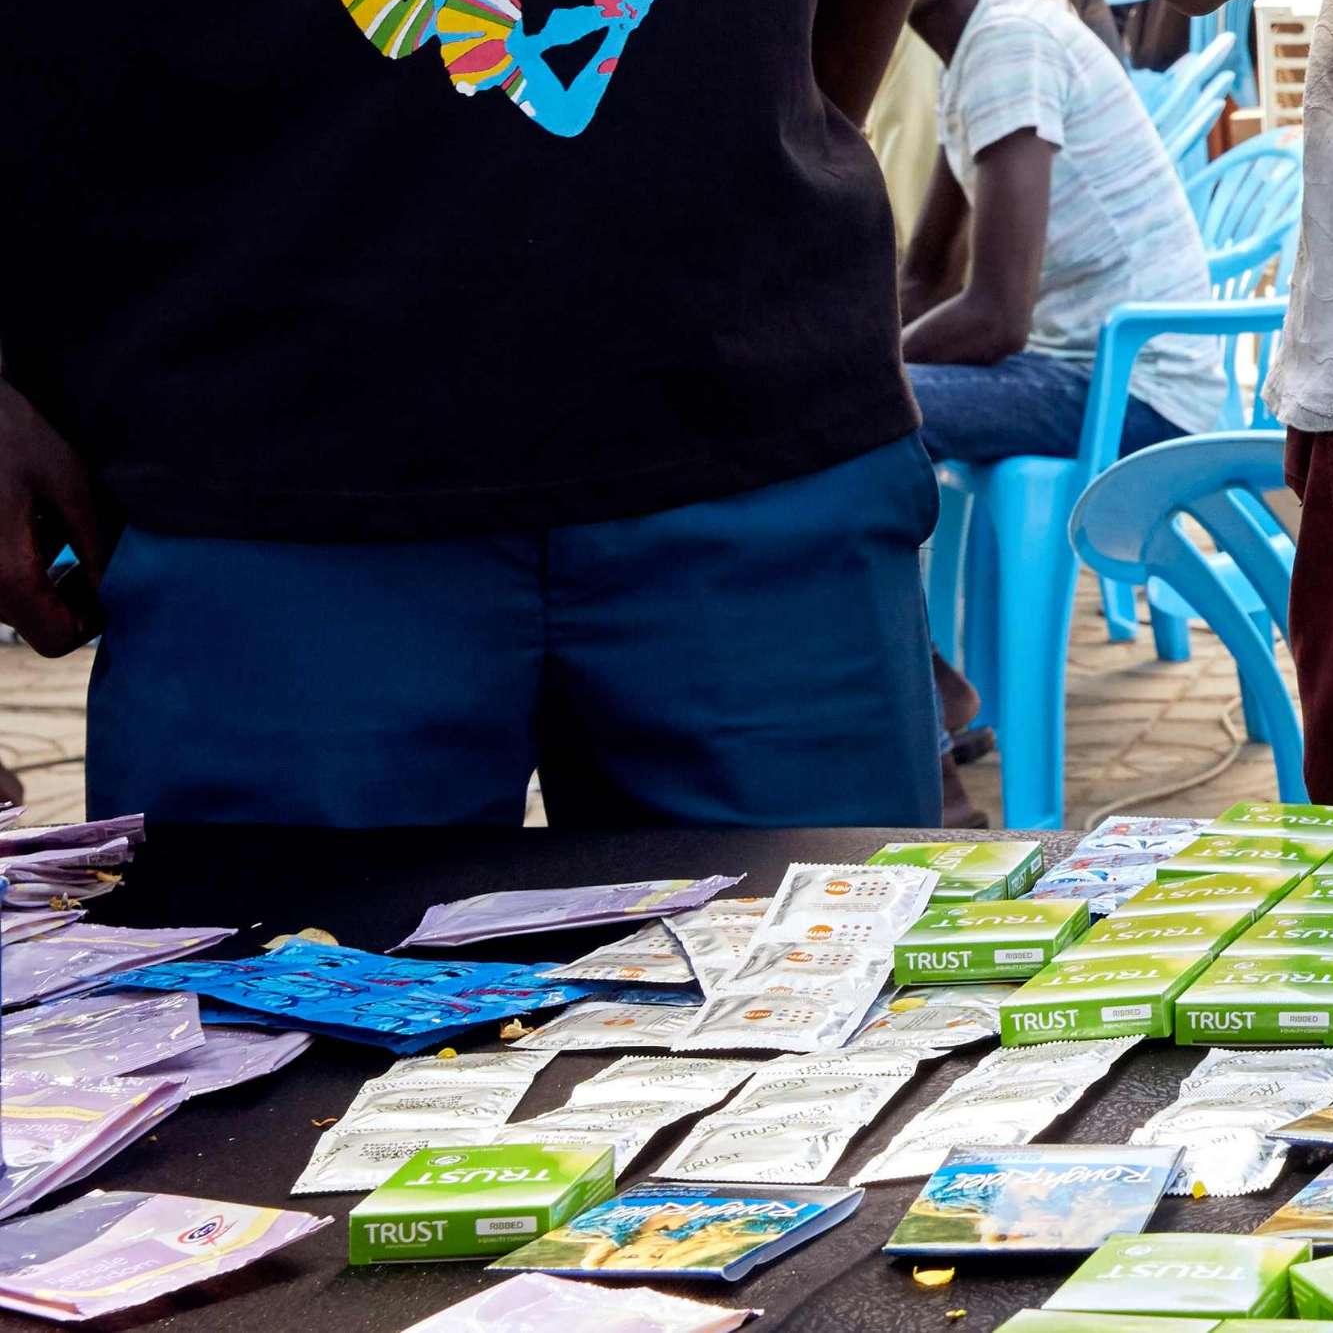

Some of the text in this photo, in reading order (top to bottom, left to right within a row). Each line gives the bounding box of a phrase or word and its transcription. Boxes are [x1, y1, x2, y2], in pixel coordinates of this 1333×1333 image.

[1194, 849, 1299, 861] TRUST
[1146, 886, 1254, 901] TRUST
[935, 914, 1048, 928] TRUST
[1091, 927, 1205, 943] TRUST
[905, 951, 972, 970] TRUST
[1047, 970, 1162, 986] TRUST
[1011, 1009, 1079, 1031] TRUST
[1187, 1011, 1257, 1030] TRUST
[405, 1168, 552, 1185] TRUST
[364, 1219, 449, 1243] TRUST
[490, 1221, 524, 1230] RIBBED
[1097, 1264, 1246, 1280] TRUST
